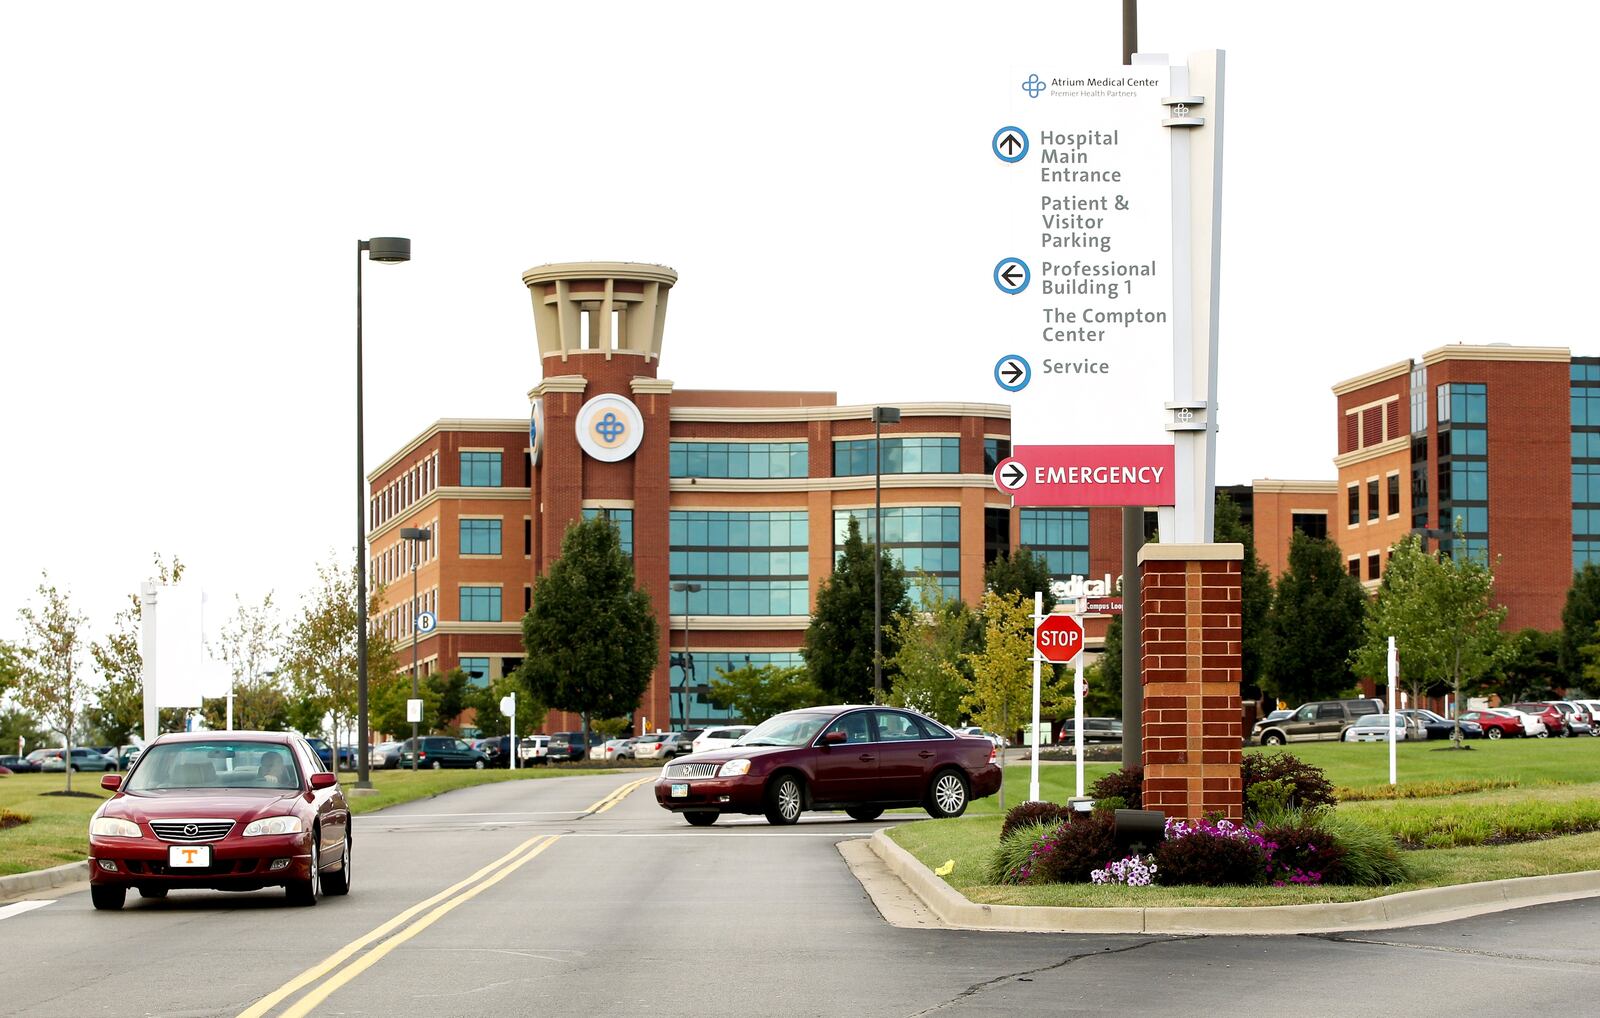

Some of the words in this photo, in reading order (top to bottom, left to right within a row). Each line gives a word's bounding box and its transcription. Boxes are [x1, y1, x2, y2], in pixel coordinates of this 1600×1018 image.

[1051, 77, 1085, 87] Atrium
[1086, 77, 1125, 87] Medical
[1126, 77, 1160, 87] Center
[1040, 130, 1118, 149] Hospital
[1040, 149, 1088, 164] Main
[1041, 168, 1122, 183] Entrance
[1041, 195, 1108, 211] Patient
[1114, 195, 1130, 211] &
[1042, 213, 1104, 229] Visitor
[1041, 232, 1112, 253] Parking
[1042, 260, 1156, 277] Professional
[1042, 279, 1119, 300] Building
[1123, 280, 1132, 295] 1
[1042, 308, 1077, 323] The
[1081, 308, 1167, 328] Compton
[1042, 327, 1106, 342] Center
[1043, 358, 1110, 374] Service
[1034, 466, 1164, 484] EMERGENCY
[422, 615, 429, 629] B
[1041, 630, 1078, 646] STOP
[181, 849, 198, 864] T
